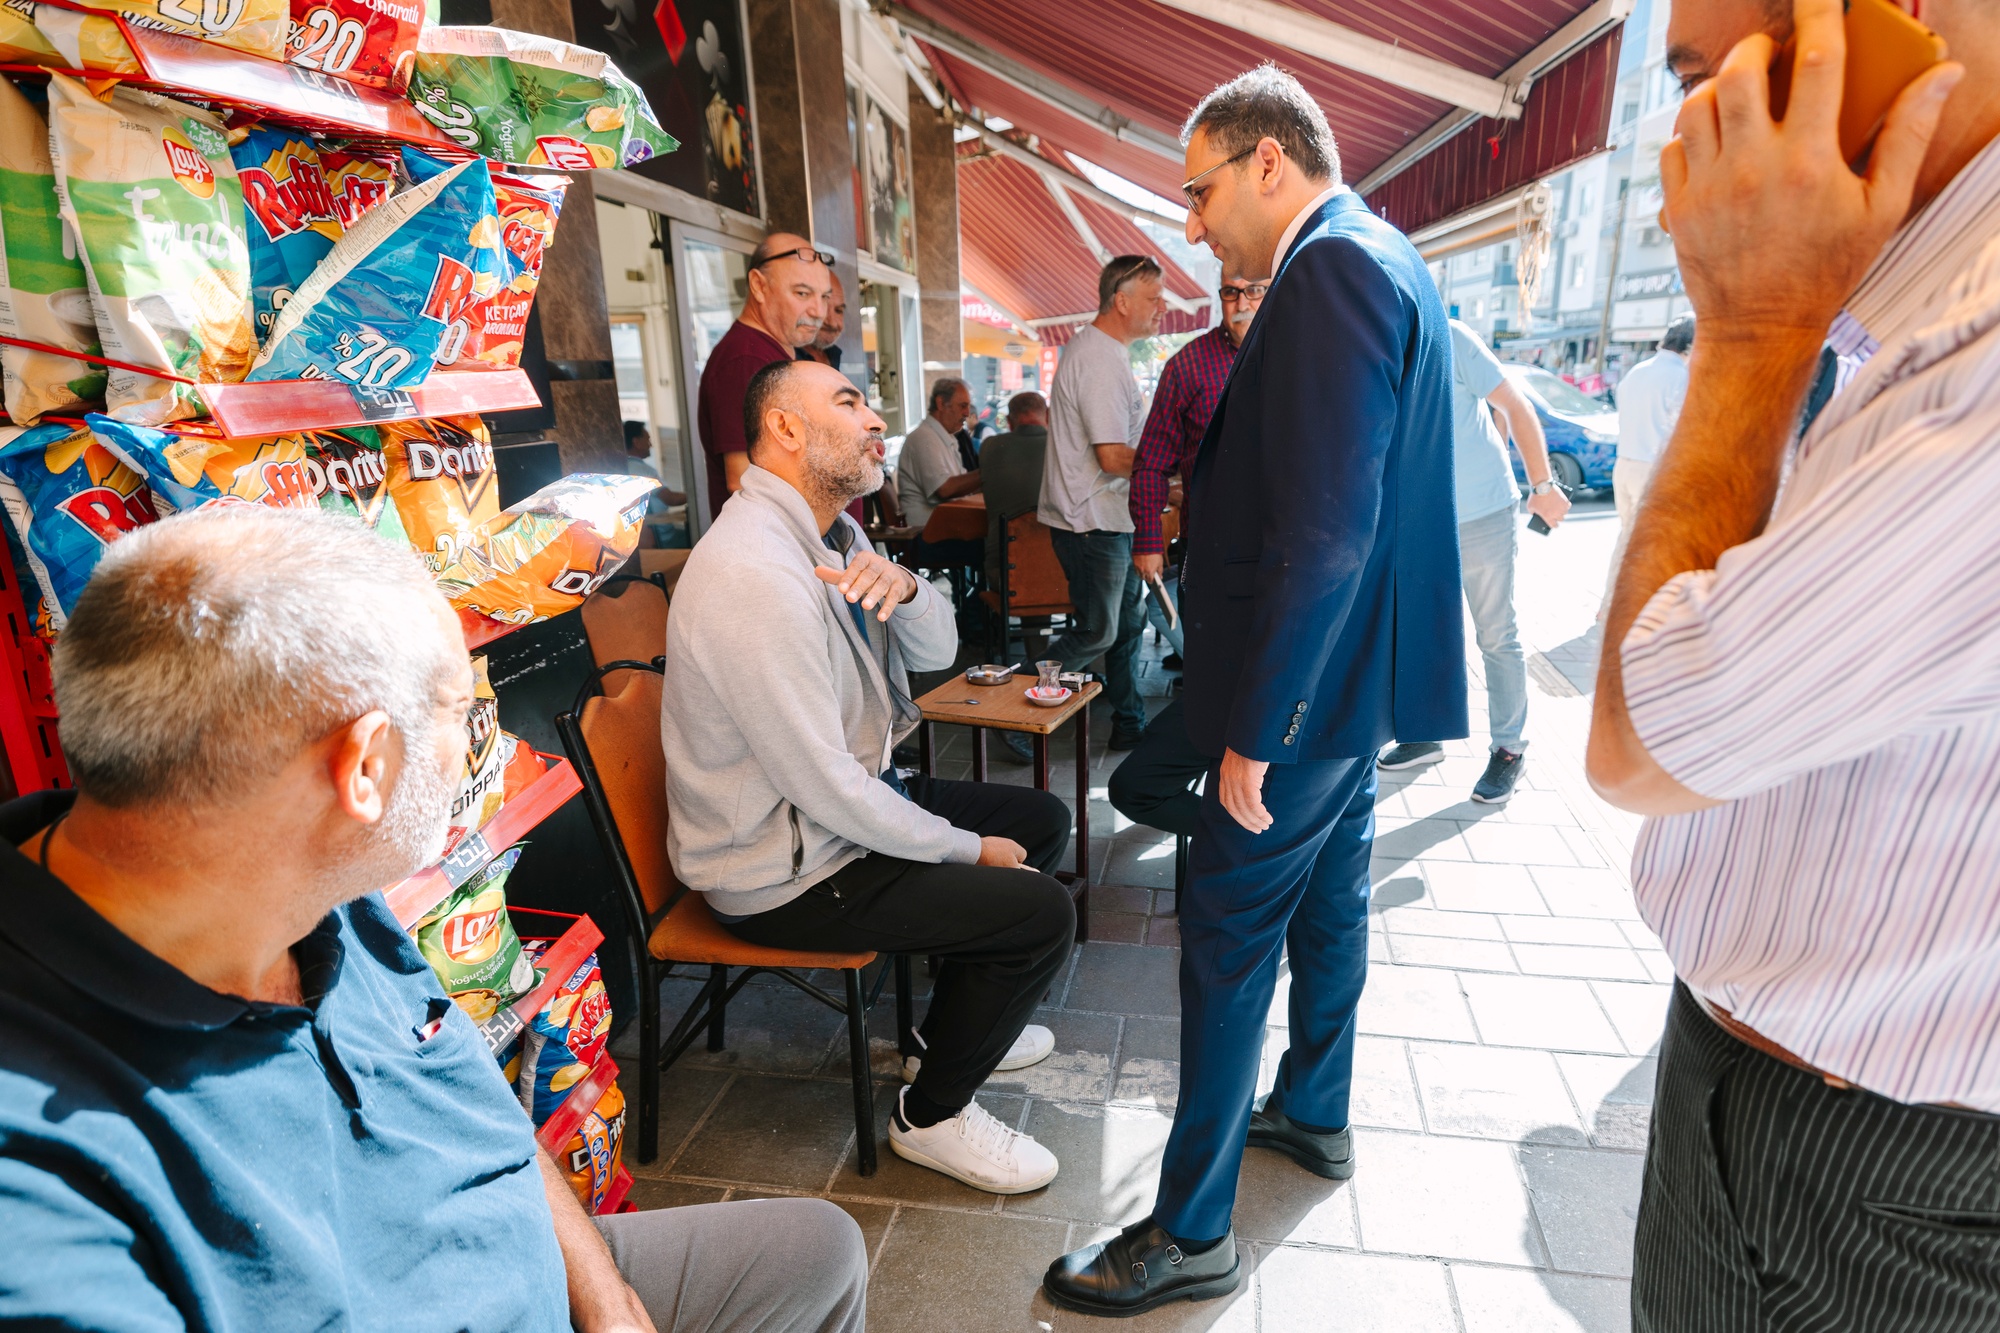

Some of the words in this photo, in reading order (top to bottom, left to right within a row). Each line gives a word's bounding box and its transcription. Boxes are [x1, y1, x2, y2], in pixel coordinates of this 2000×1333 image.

[500, 118, 516, 162] Yoğurt
[485, 300, 529, 322] KETÇAP
[481, 320, 526, 337] AROMALI
[334, 331, 412, 387] %20
[450, 968, 485, 987] Yoğurt
